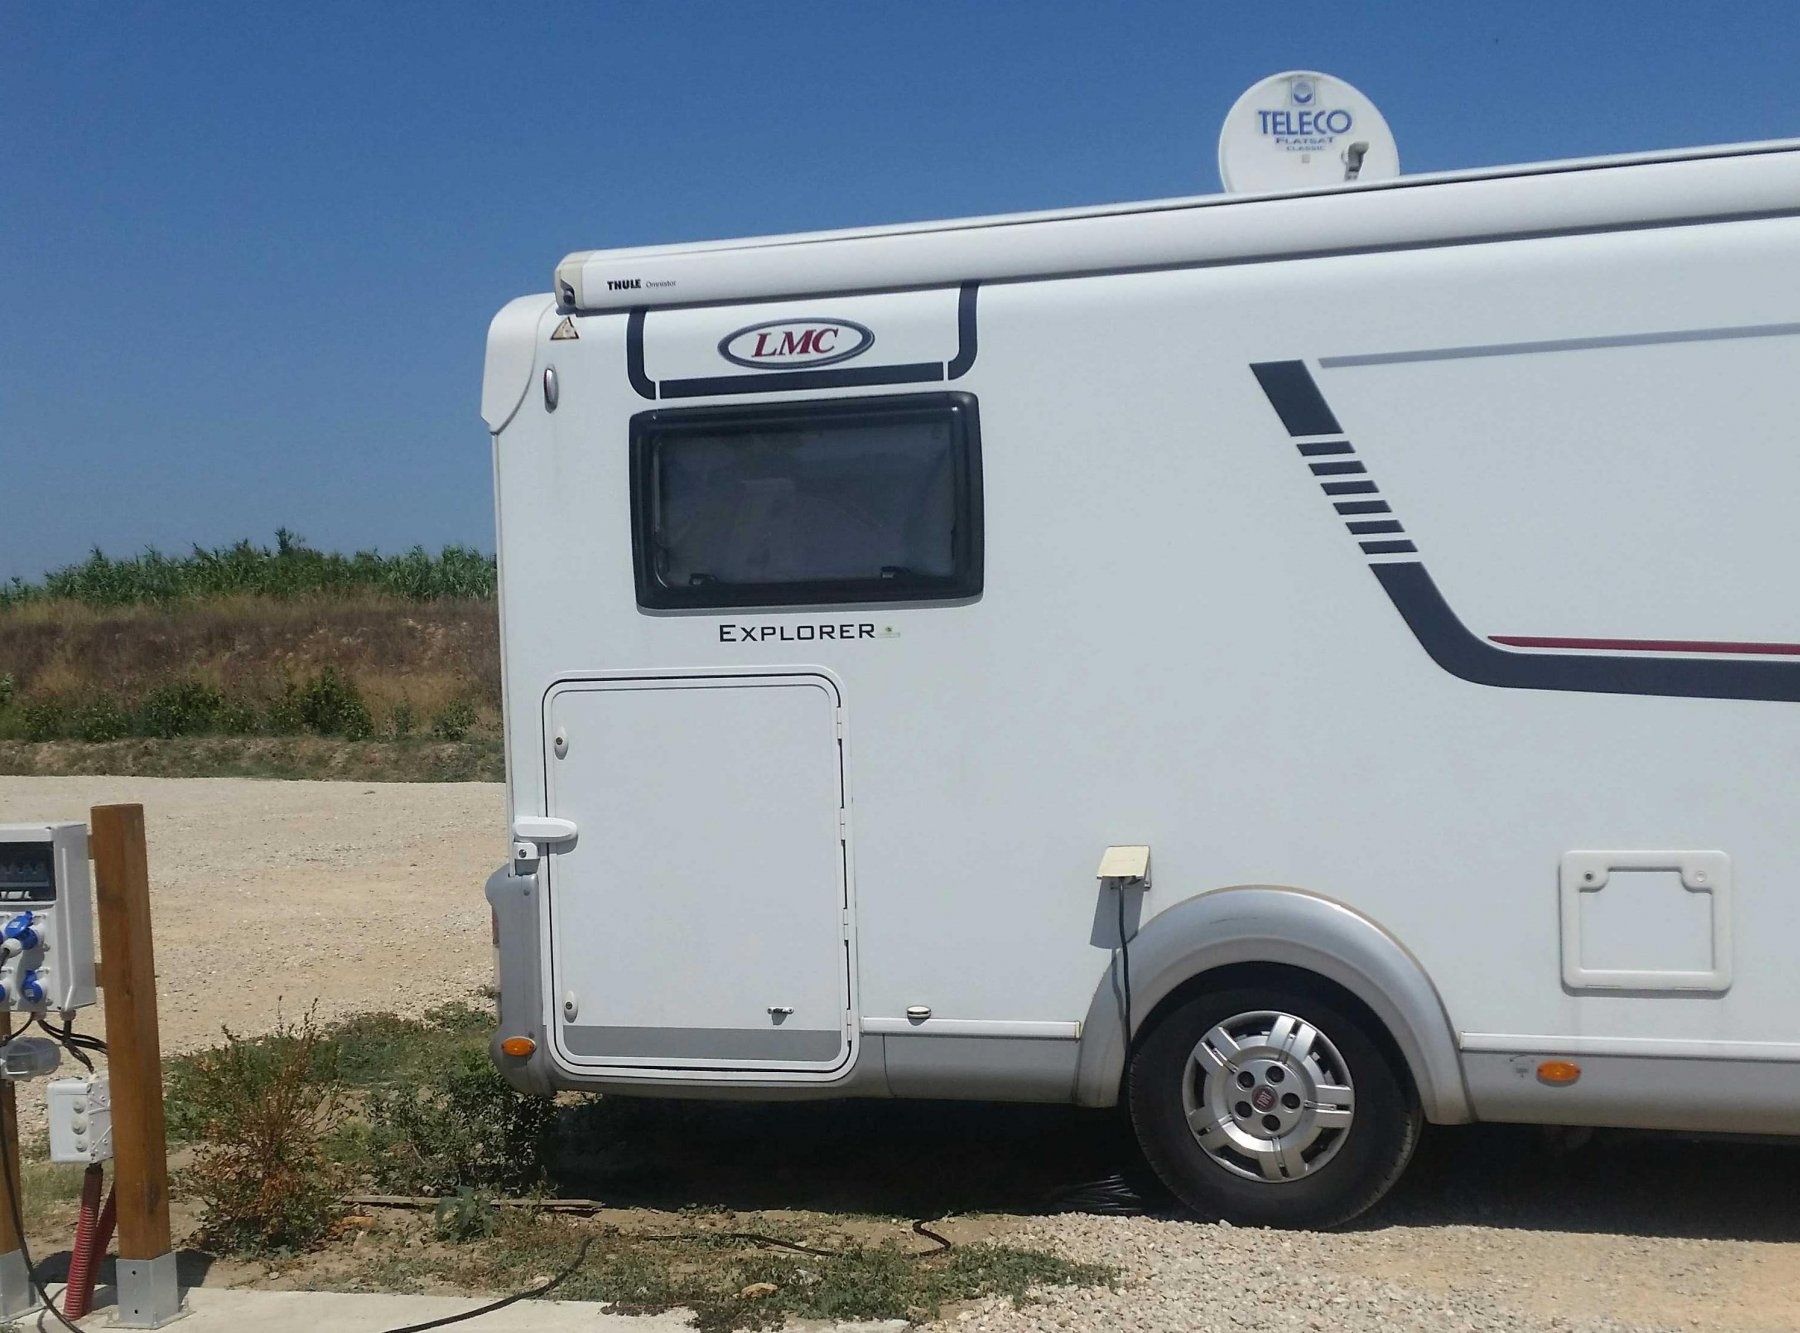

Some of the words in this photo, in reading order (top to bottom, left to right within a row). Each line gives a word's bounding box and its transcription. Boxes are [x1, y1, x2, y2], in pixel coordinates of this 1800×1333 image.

[1258, 109, 1353, 136] TELECO
[607, 278, 642, 291] THULE
[646, 279, 677, 289] Omnistor
[750, 327, 839, 358] LMC
[719, 623, 876, 643] EXPLORER
